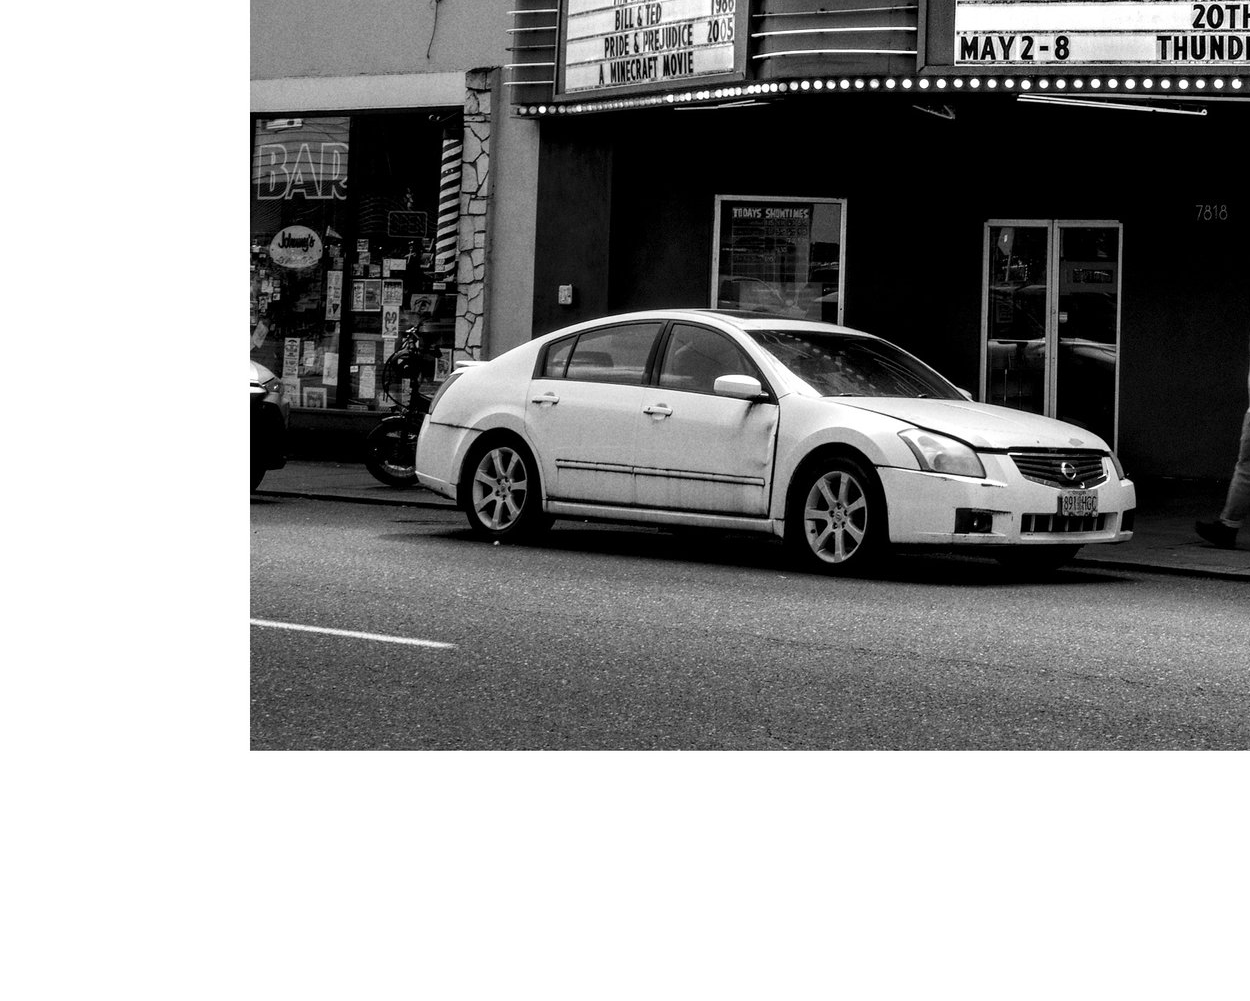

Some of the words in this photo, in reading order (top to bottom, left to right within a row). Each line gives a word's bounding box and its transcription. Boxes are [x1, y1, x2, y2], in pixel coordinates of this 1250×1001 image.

[615, 6, 634, 31] BILL
[636, 4, 643, 27] &
[646, 2, 663, 26] TED
[604, 33, 630, 58] PRIDE
[633, 31, 640, 54] &
[642, 23, 694, 52] PREJUDICE
[707, 18, 734, 43] 2005
[959, 35, 1015, 61] MAY
[599, 60, 605, 85] A
[610, 55, 659, 84] MINECRAFT
[662, 51, 695, 77] MOVIE
[256, 142, 349, 201] BAR
[732, 208, 762, 219] TODAYS
[765, 208, 809, 219] SHOWTIMES
[1195, 204, 1229, 222] 7818
